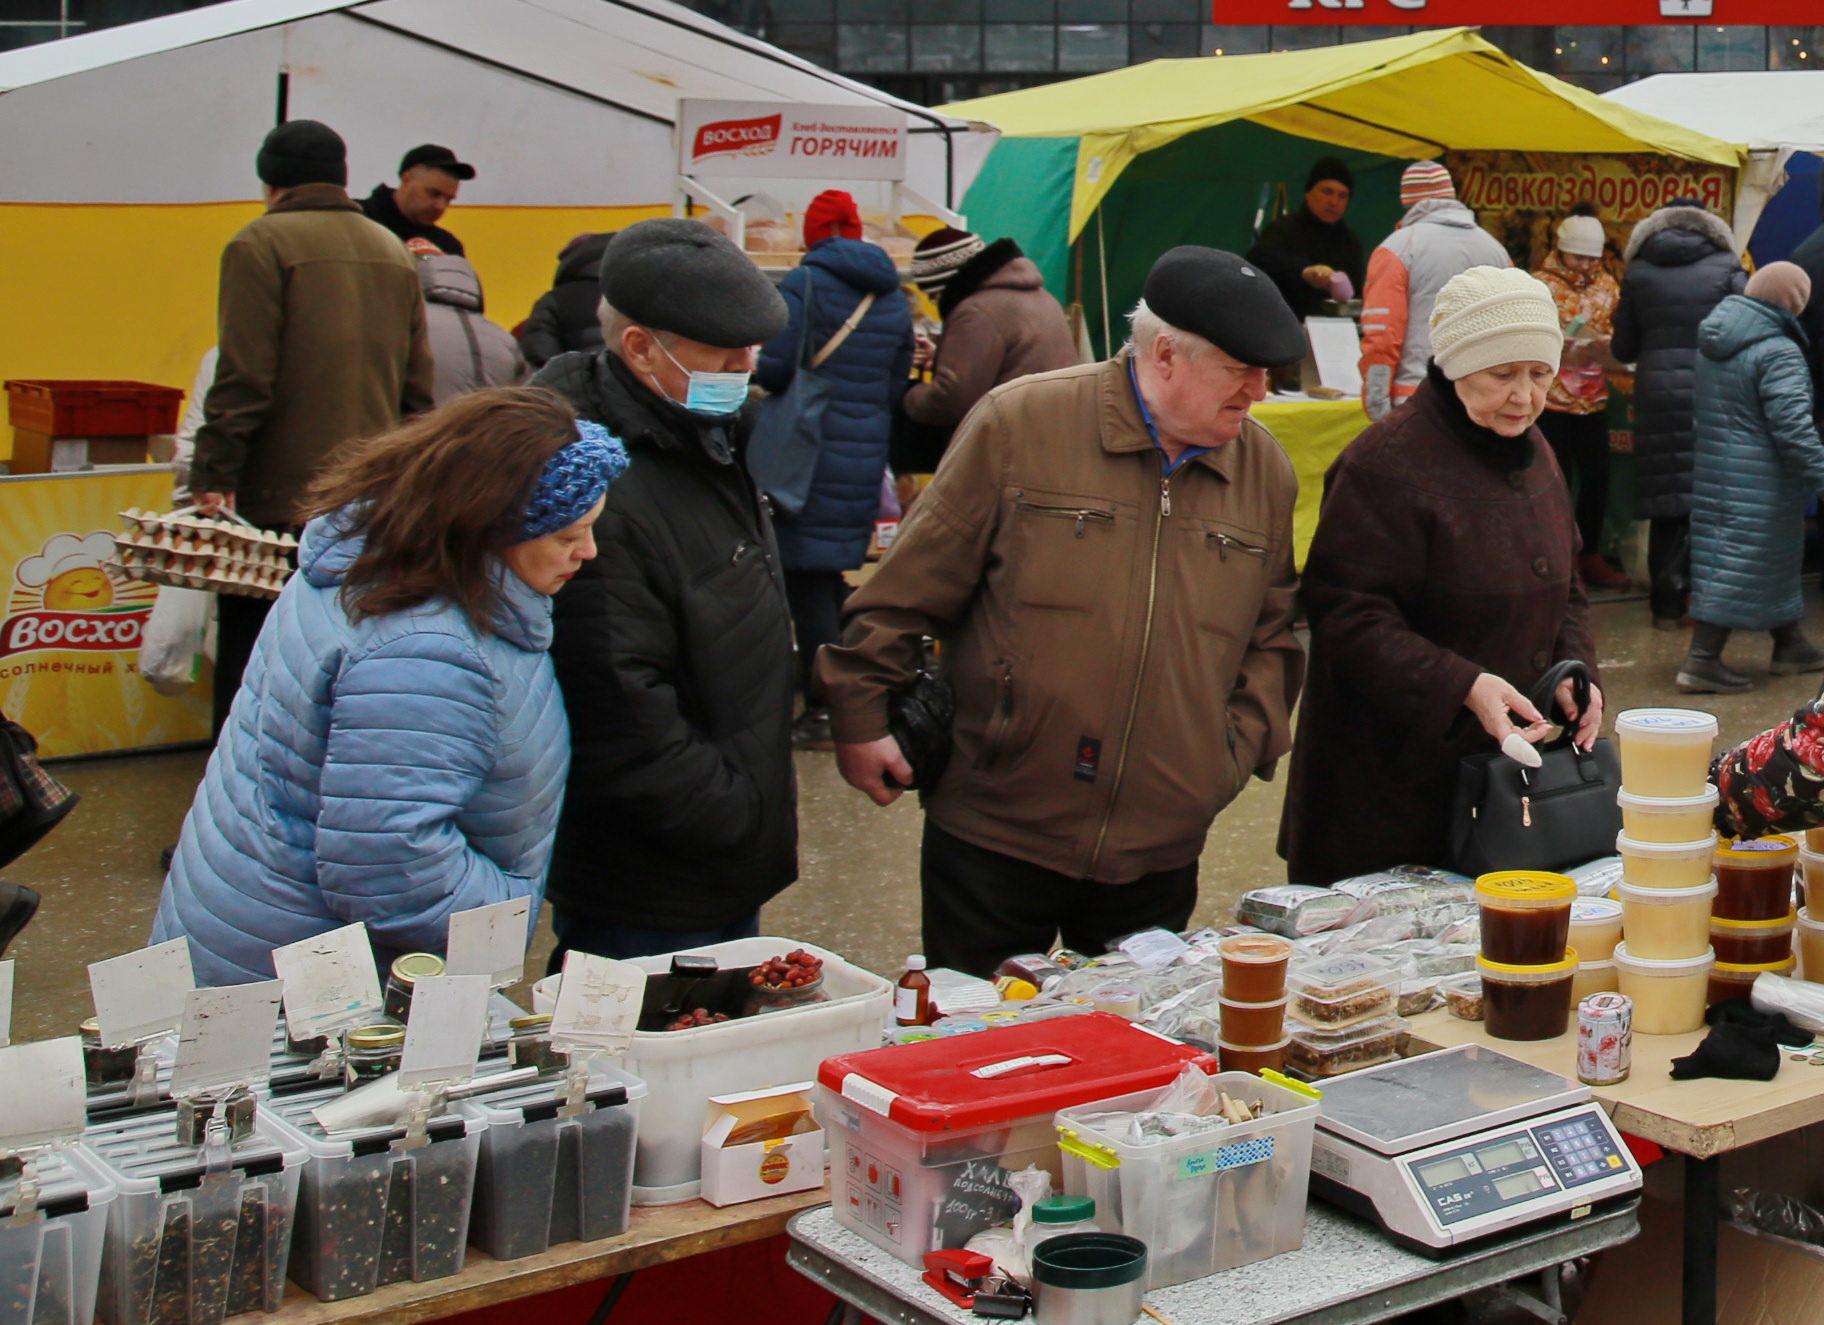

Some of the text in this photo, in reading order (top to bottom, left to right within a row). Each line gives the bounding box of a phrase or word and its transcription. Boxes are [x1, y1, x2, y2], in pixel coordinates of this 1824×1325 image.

[702, 124, 773, 146] ВОСХОД
[790, 136, 898, 158] ГОРЯЧИМ
[1463, 165, 1557, 208] Лавка
[1437, 1192, 1464, 1207] CAS
